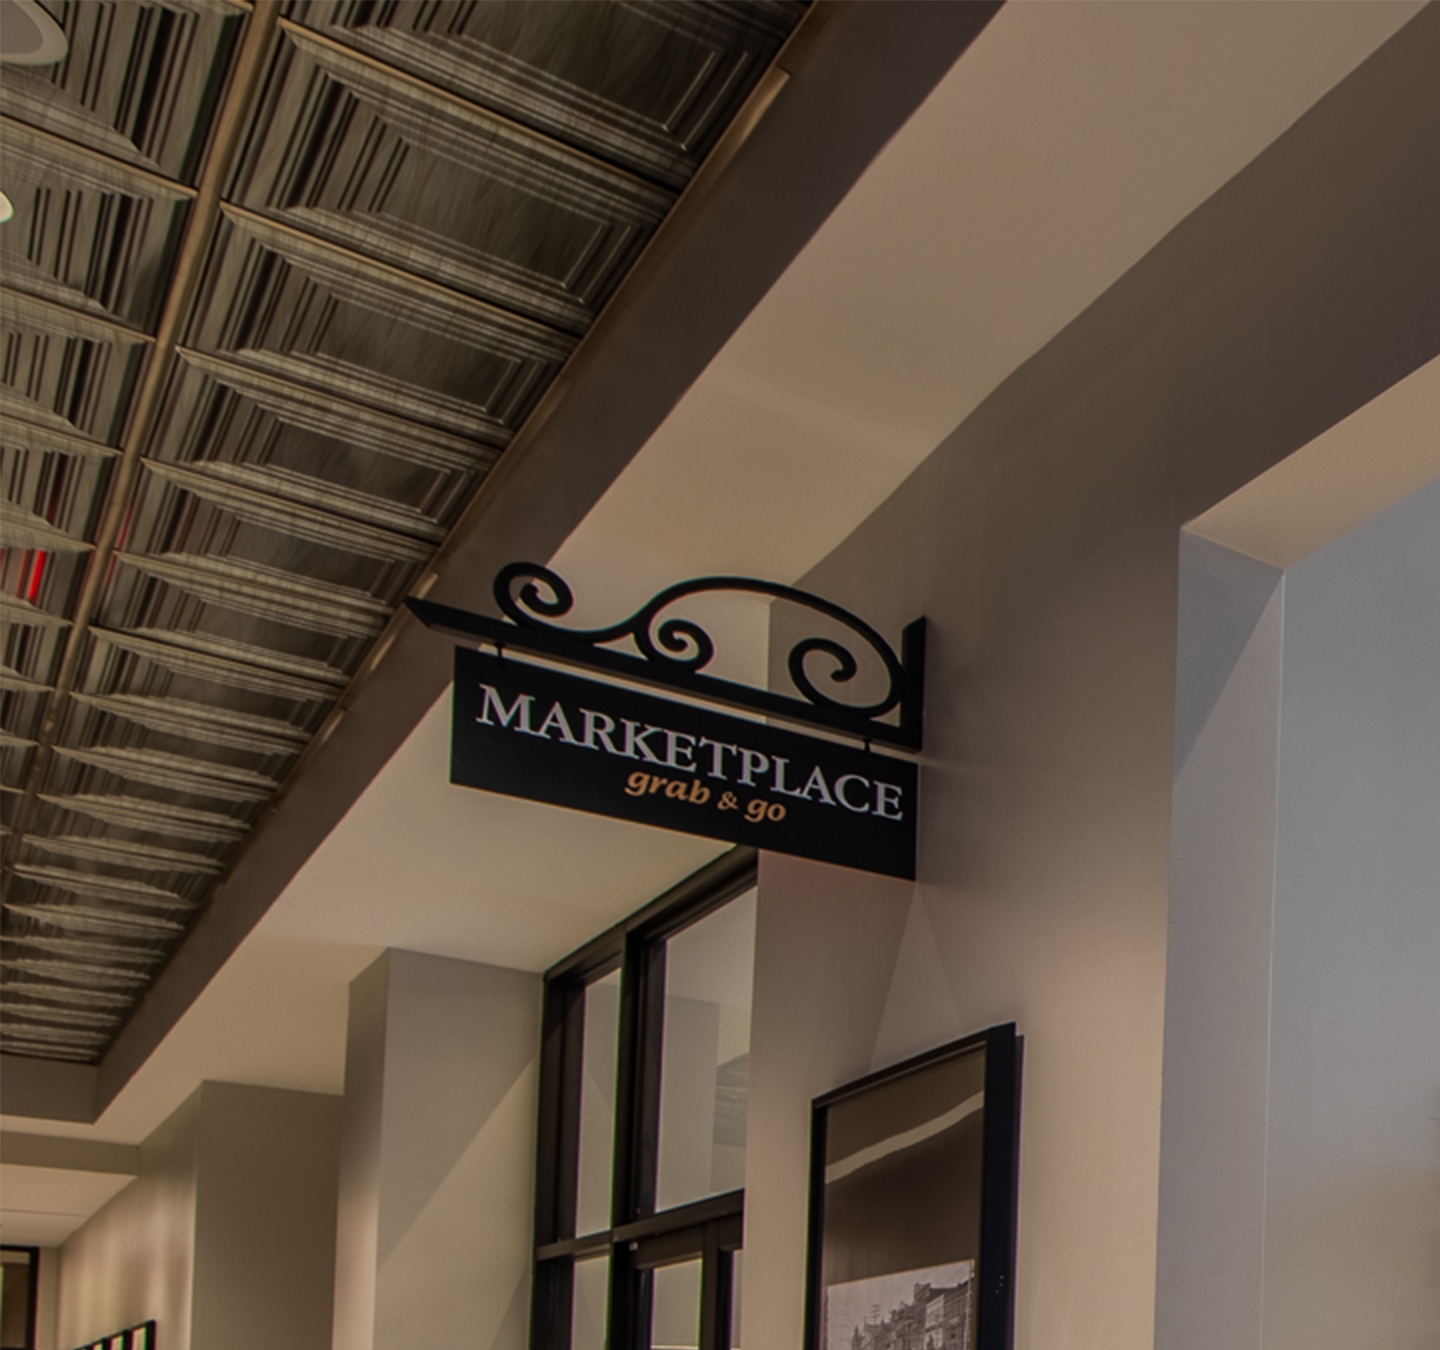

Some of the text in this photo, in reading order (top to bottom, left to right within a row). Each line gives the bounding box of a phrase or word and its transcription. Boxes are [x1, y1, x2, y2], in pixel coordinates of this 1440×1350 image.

[476, 683, 904, 821] MARKETPLACE
[625, 771, 787, 823] grab & go
